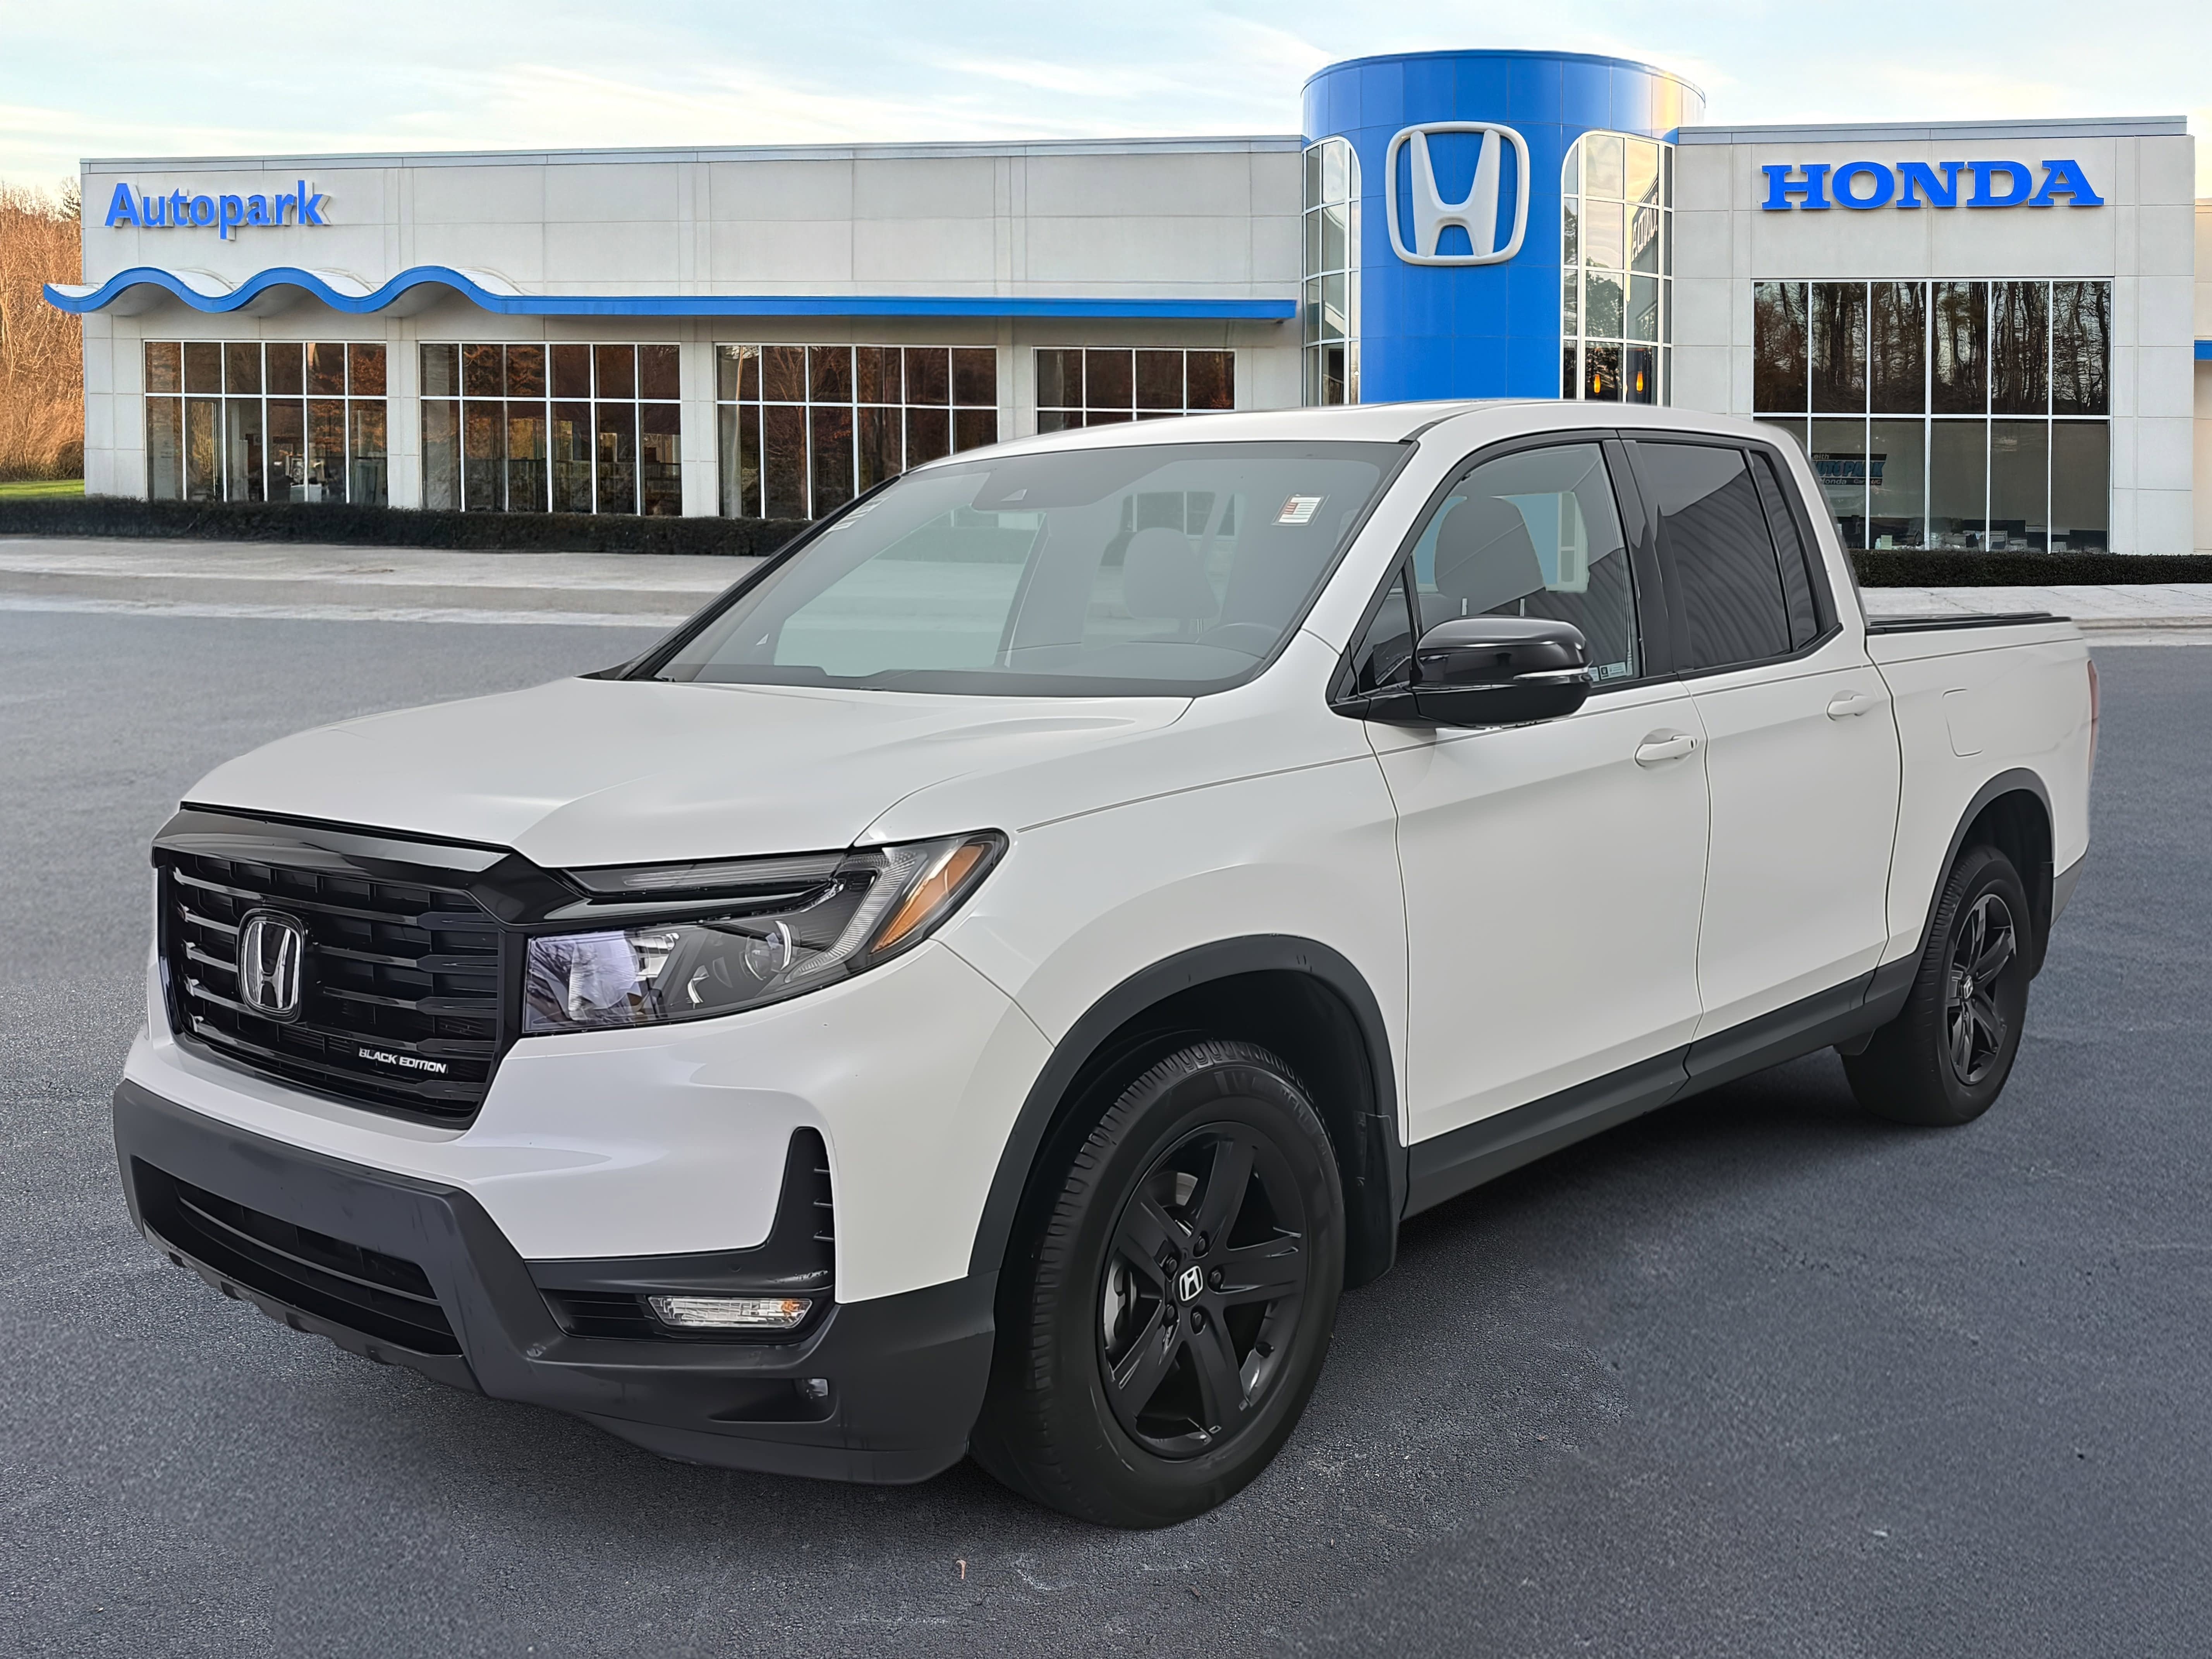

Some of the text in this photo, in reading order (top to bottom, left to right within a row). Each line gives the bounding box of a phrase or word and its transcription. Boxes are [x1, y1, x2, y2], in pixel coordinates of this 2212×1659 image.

[105, 180, 325, 240] Autopark
[1761, 159, 2105, 210] HONDA
[359, 1047, 447, 1074] BLACK EDITION
